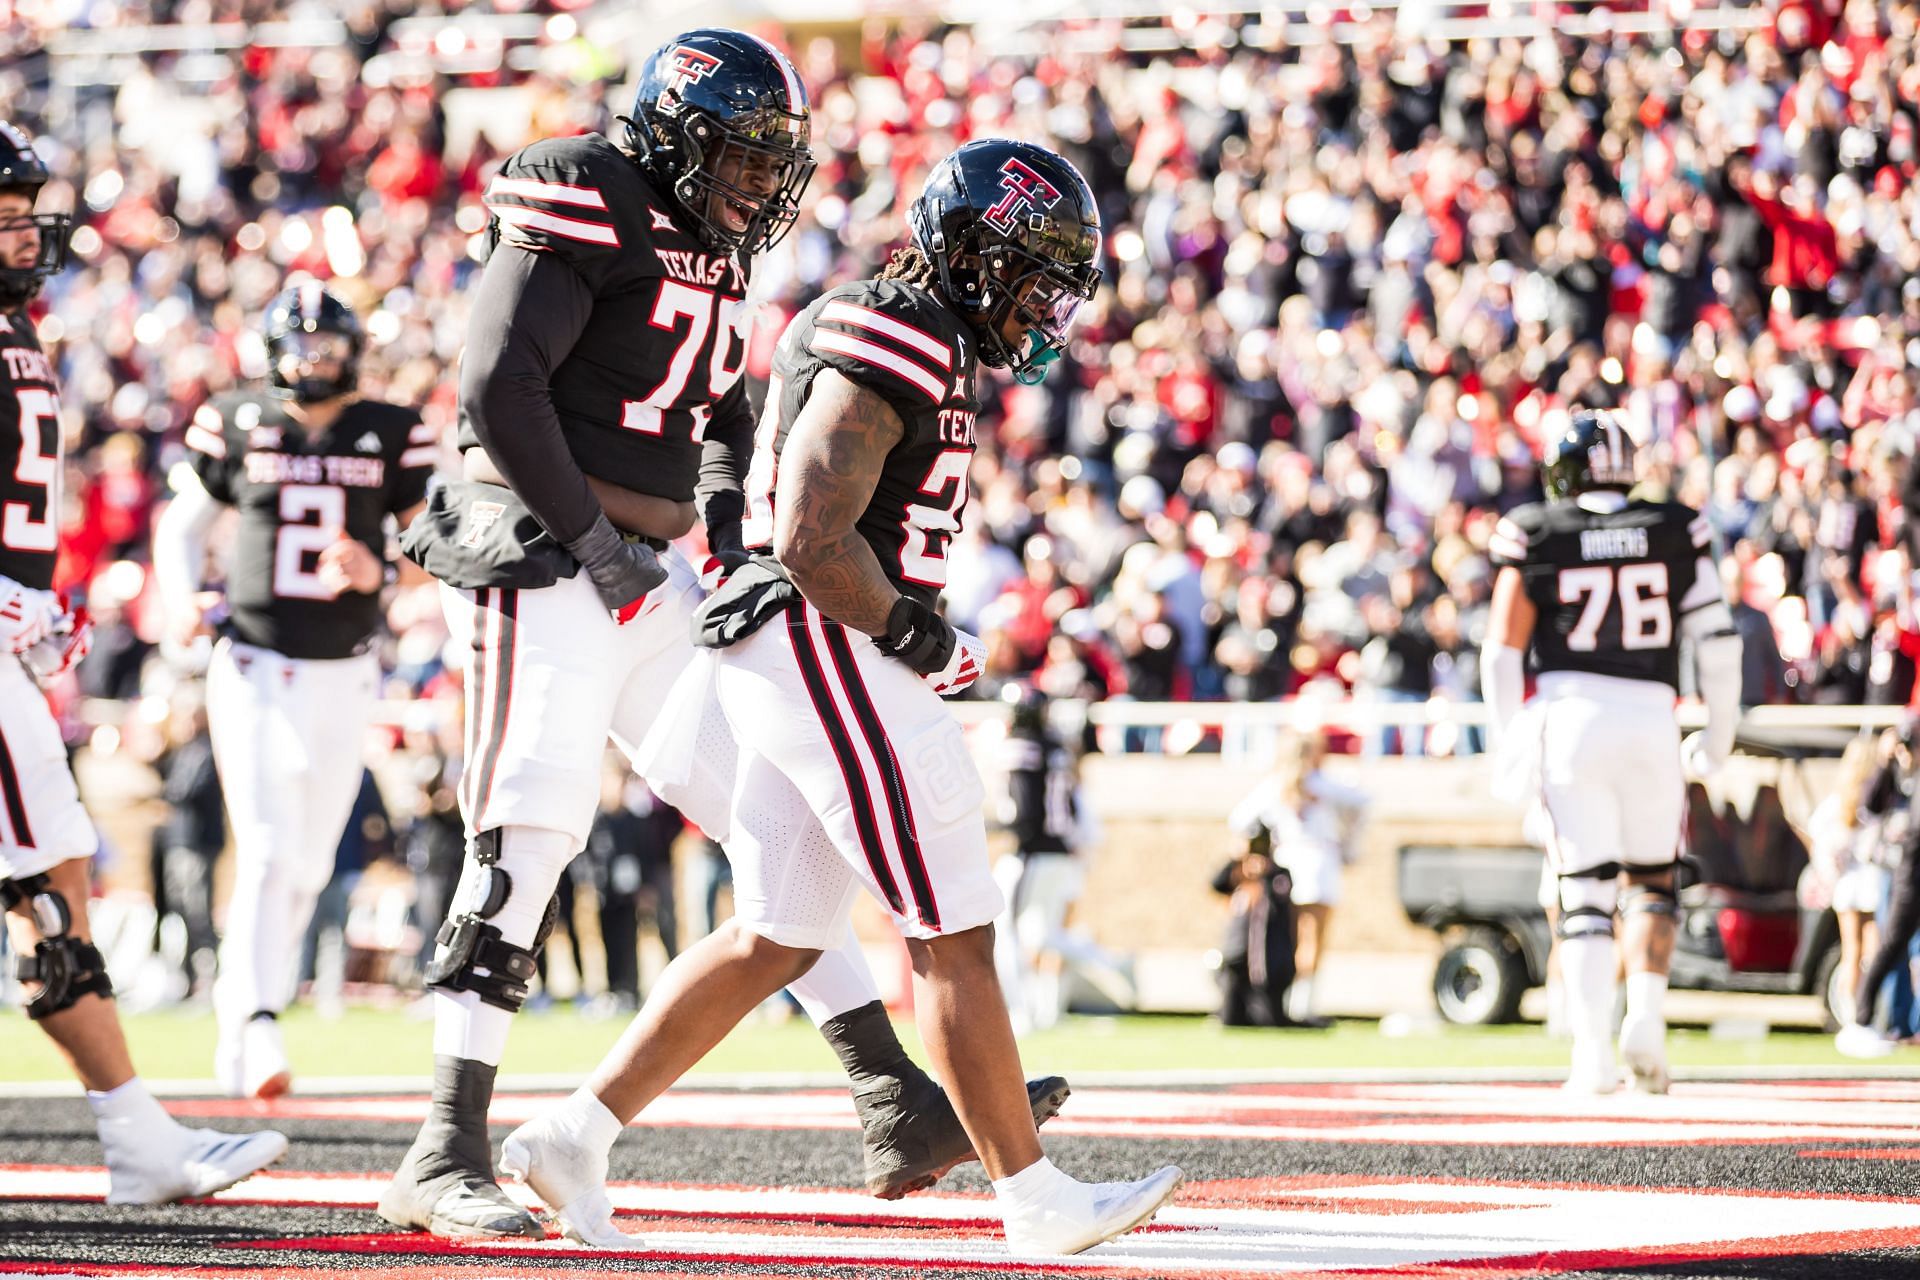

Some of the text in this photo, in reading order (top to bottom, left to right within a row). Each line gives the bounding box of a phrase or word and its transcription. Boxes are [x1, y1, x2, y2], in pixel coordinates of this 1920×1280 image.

[654, 248, 727, 286] TEXAS
[273, 483, 346, 600] 2
[1557, 560, 1673, 652] 76
